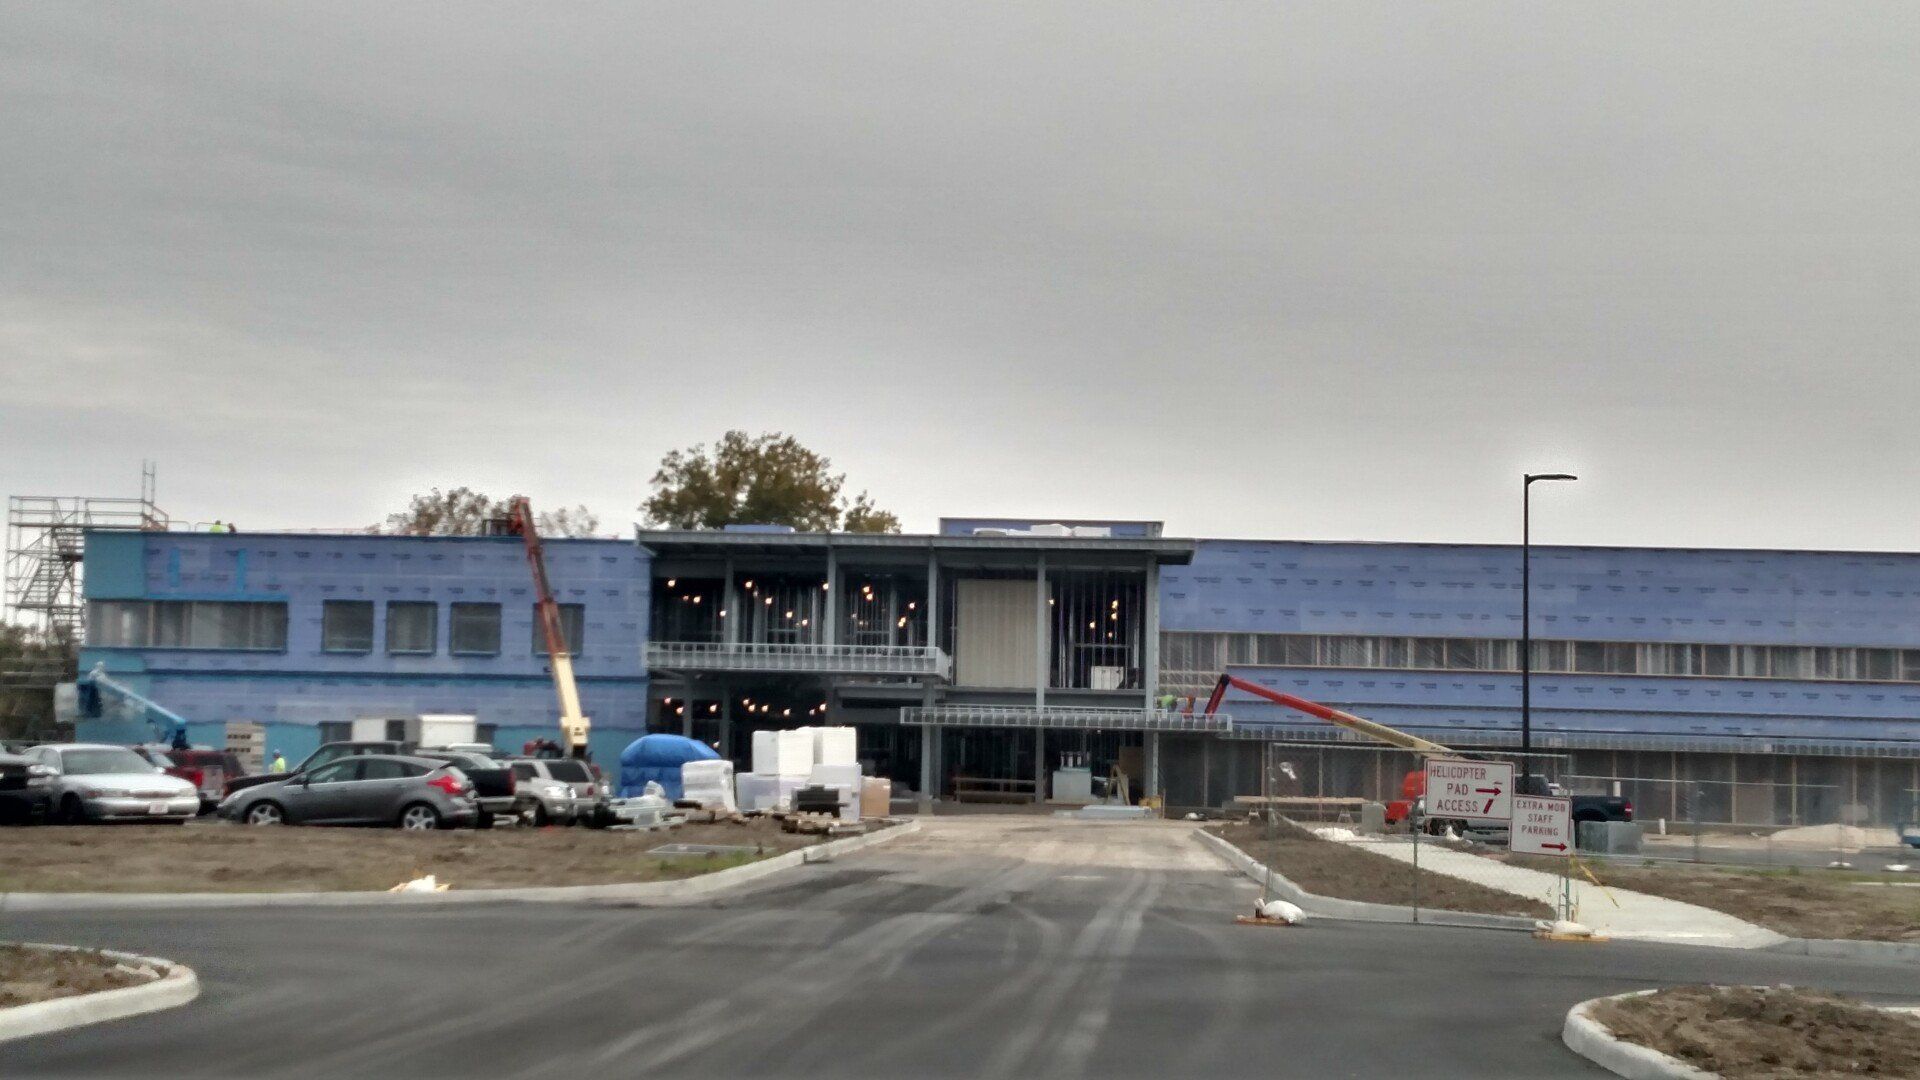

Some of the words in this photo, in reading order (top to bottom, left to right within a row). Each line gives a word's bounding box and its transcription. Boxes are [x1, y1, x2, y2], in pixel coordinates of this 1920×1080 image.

[1430, 765, 1486, 779] HELICOPTER
[1447, 783, 1469, 796] PAD
[1437, 799, 1478, 812] ACCESS
[1516, 800, 1543, 811] EXTRA
[1527, 813, 1554, 823] STAFF
[1521, 825, 1559, 836] PARKING
